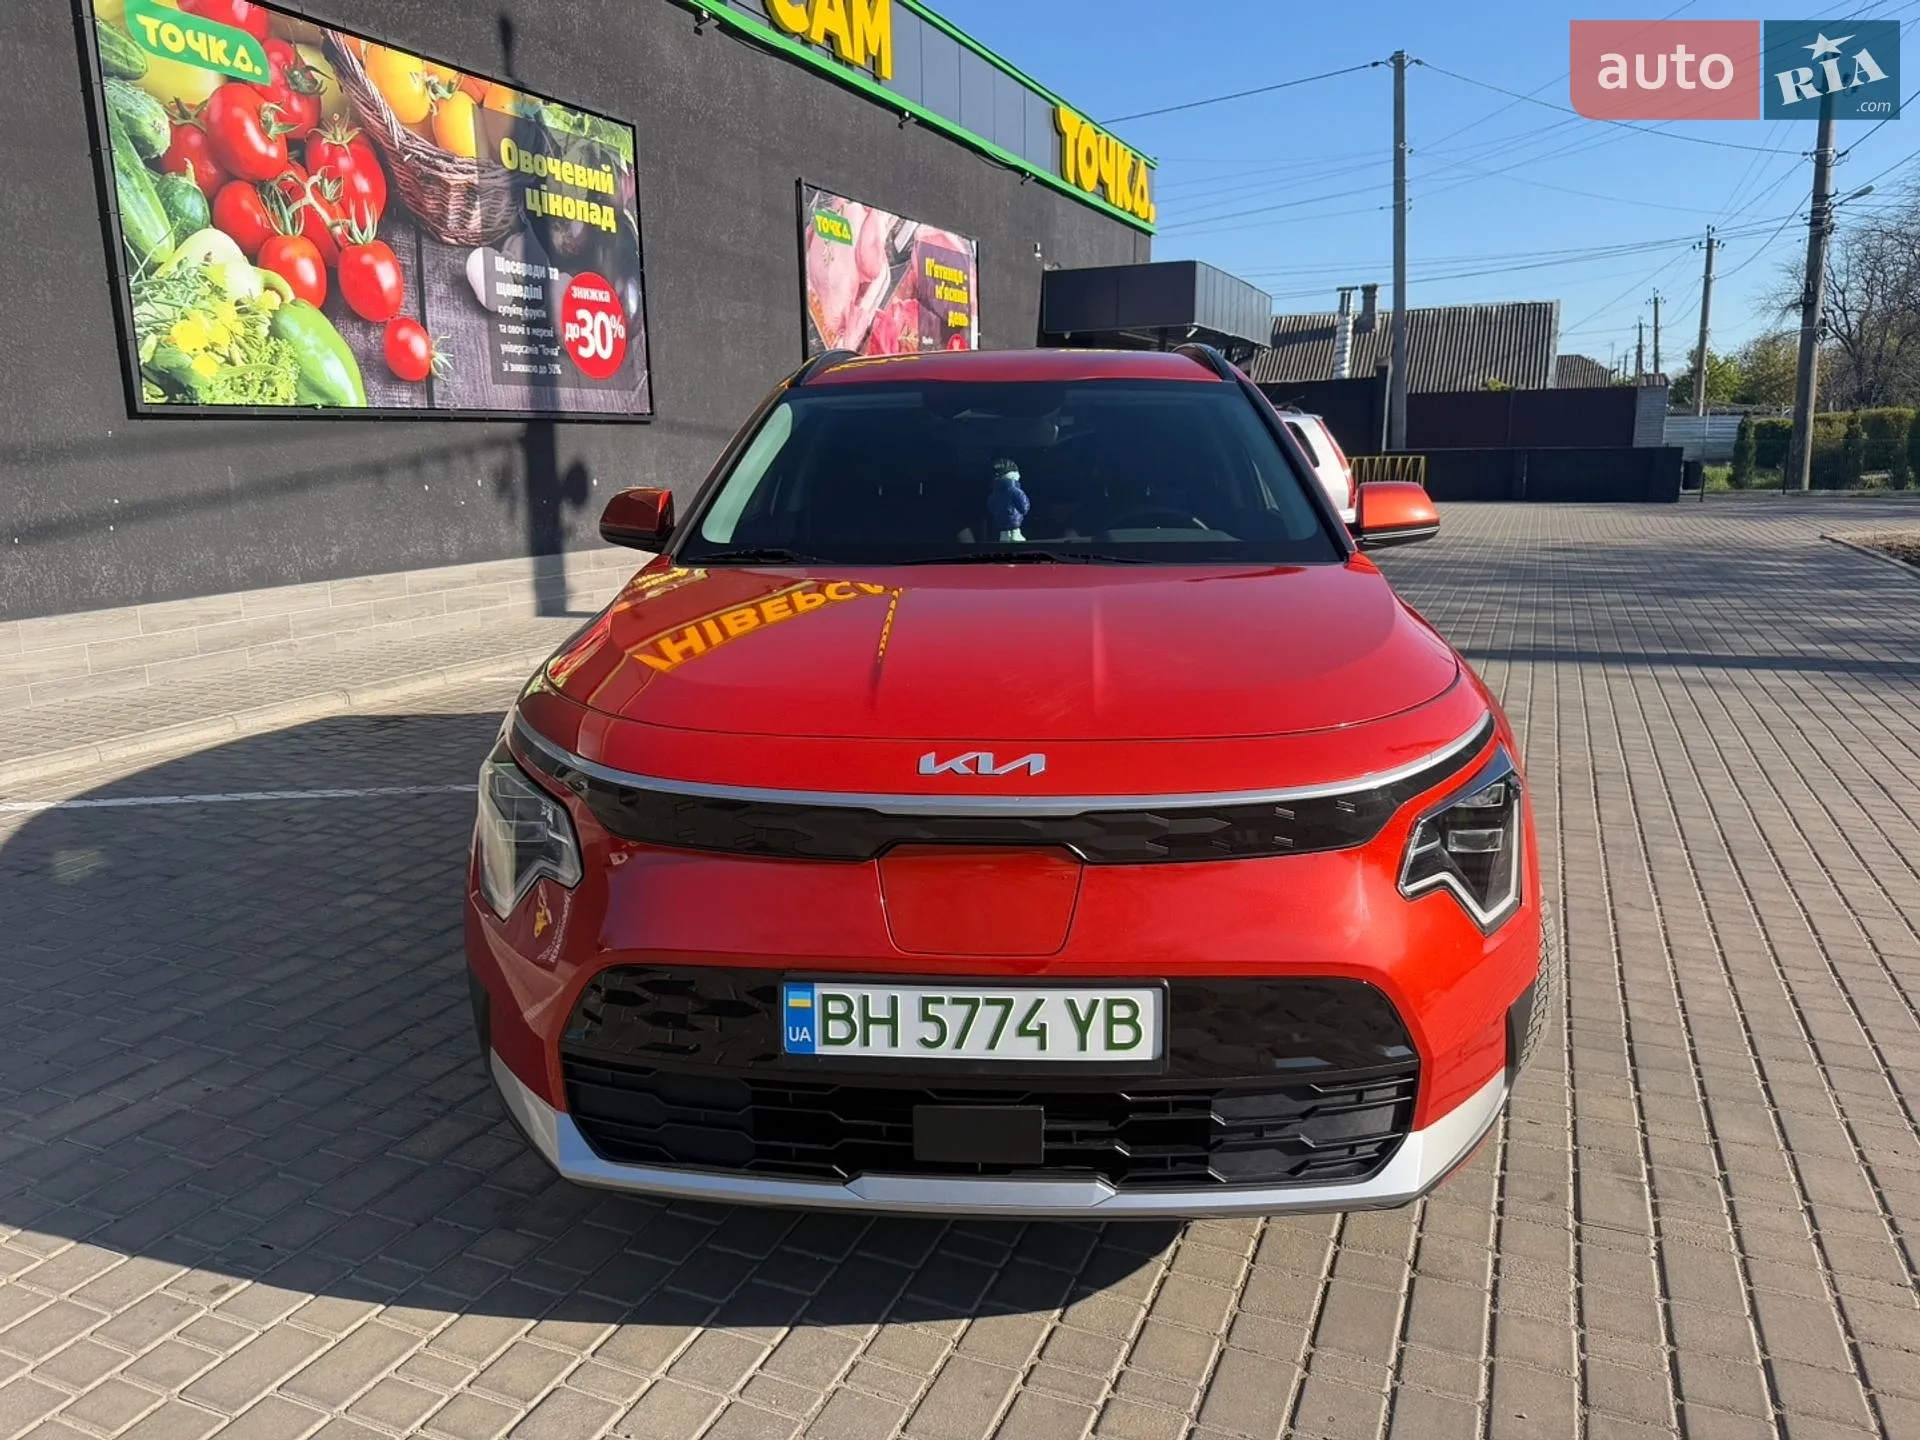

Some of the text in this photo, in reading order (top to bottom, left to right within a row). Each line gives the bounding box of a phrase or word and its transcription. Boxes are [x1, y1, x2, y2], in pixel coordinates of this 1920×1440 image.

[500, 137, 614, 195] Овочевий
[1056, 105, 1156, 224] ТОЧКА.
[525, 183, 617, 233] цінопад
[494, 256, 559, 280] Щосереди та
[496, 281, 542, 300] щонеділі
[570, 285, 611, 303] знижка
[565, 308, 625, 360] до 30%
[789, 1027, 811, 1043] UA
[821, 992, 1144, 1052] BH 5774 YB
